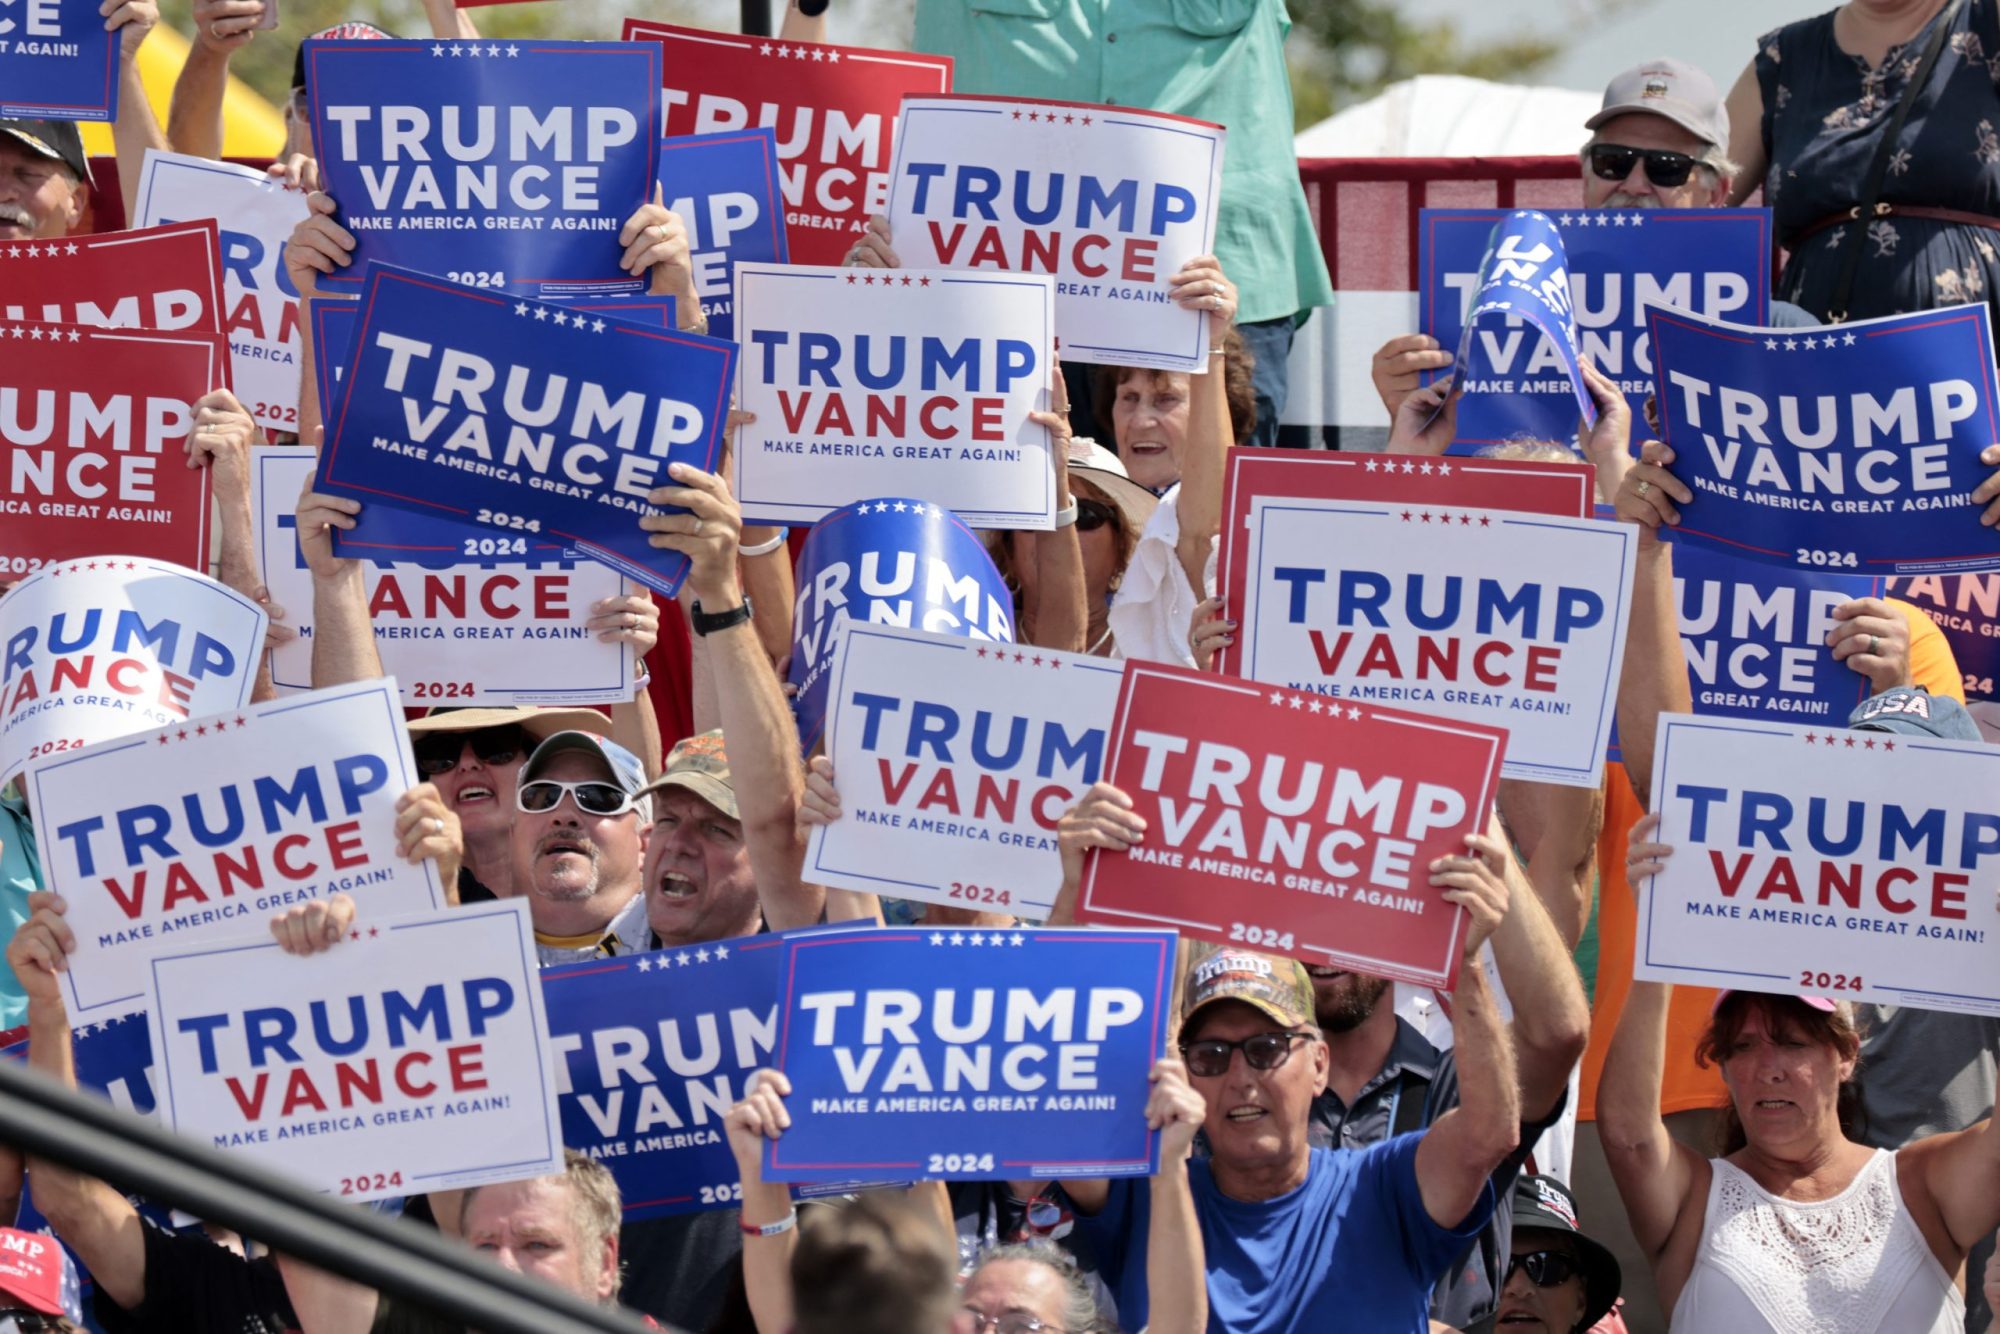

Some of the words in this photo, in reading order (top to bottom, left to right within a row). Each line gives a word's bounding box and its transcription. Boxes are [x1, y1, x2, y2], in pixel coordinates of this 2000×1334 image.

[15, 41, 78, 57] AGAIN!
[327, 106, 638, 162] TRUMP
[660, 87, 898, 168] TRUM
[359, 165, 600, 211] VANCE
[781, 164, 890, 216] NCE
[906, 163, 1197, 236] TRUMP
[349, 216, 393, 230] MAKE
[398, 216, 477, 230] AMERICA
[483, 217, 544, 230] GREAT
[551, 218, 617, 231] AGAIN!
[786, 212, 844, 231] GREAT
[928, 221, 1159, 283] VANCE
[447, 271, 505, 288] 2024
[1057, 283, 1100, 297] REAT
[1108, 288, 1171, 304] AGAIN!
[1443, 272, 1750, 327] TUMP
[700, 301, 731, 316] GAI
[229, 342, 293, 364] MERICA
[752, 329, 1036, 393] TRUMP
[375, 332, 703, 458] TRUMP
[1462, 380, 1514, 393] MAKE
[1520, 380, 1577, 393] AMER
[1610, 381, 1655, 394] REA
[1669, 369, 1978, 449] TRUMP
[0, 387, 192, 453] UMP
[256, 402, 296, 423] 202
[777, 390, 1005, 442] VANCE
[372, 437, 428, 462] MAKE
[433, 451, 521, 485] AMERICA
[529, 476, 592, 500] GREAT
[402, 397, 660, 500] VANCE
[764, 440, 803, 454] MAKE
[810, 443, 885, 458] AMERICA
[893, 446, 952, 460] GREAT
[960, 448, 1021, 462] AGAIN!
[1703, 434, 1951, 495] VANCE
[11, 449, 156, 502] NCE
[1694, 475, 1738, 499] MAKE
[1743, 489, 1825, 513] AMERICA
[1831, 499, 1894, 513] GREAT
[1902, 492, 1971, 511] AGAIN!
[39, 501, 101, 518] GREAT
[107, 509, 172, 523] AGAIN!
[476, 509, 540, 533] 2024
[464, 538, 527, 556] 2024
[1796, 548, 1859, 568] 2024
[369, 575, 570, 618] ANCE
[1273, 566, 1605, 644] TRUMP
[1673, 578, 1854, 645] UMP
[374, 626, 445, 639] MERICA
[454, 626, 514, 639] GREAT
[522, 626, 589, 639] AGAIN!
[1923, 609, 1973, 633] RICA
[3, 608, 235, 684] RUMP
[1308, 630, 1562, 694] VANCE
[1683, 639, 1817, 694] NCE
[414, 682, 475, 698] 2024
[1349, 685, 1435, 701] AMERICA
[1443, 690, 1504, 708] GREAT
[1509, 698, 1571, 715] AGAIN!
[1700, 691, 1760, 709] GREAT
[1766, 698, 1829, 714] AGAIN!
[1862, 694, 1930, 720] USA
[1964, 674, 1994, 694] 24
[4, 697, 65, 735] AMERICA
[73, 695, 136, 712] GREAT
[143, 709, 178, 727] AGA
[28, 738, 84, 760] 2024
[852, 692, 1106, 786] TRUM
[878, 758, 1074, 831] VANC
[1133, 730, 1467, 841] TRUMP
[57, 753, 389, 878] TRUMP
[856, 809, 901, 827] MAKE
[908, 817, 990, 842] AMERICA
[998, 832, 1060, 851] GREAT
[1676, 784, 2000, 870] TRUMP
[1158, 797, 1417, 890] VANCE
[102, 821, 370, 920] VANCE
[1129, 847, 1183, 868] MAKE
[1188, 857, 1277, 886] AMERICA
[1284, 876, 1349, 899] GREAT
[1353, 888, 1424, 914] AGAIN!
[1708, 850, 1969, 920] VANCE
[98, 925, 154, 949] MAKE
[161, 904, 249, 934] AMERICA
[256, 886, 319, 911] GREAT
[327, 868, 394, 895] AGAIN!
[949, 882, 1011, 907] 2024
[1229, 923, 1295, 951] 2024
[1686, 902, 1740, 919] MAKE
[1749, 908, 1837, 928] AMERICA
[1846, 918, 1909, 935] GREAT
[1916, 924, 1984, 943] AGAIN!
[1195, 957, 1273, 986] Trump
[1800, 971, 1863, 992] 2024
[178, 976, 515, 1075] TRUMP
[800, 988, 1144, 1046] TRUMP
[549, 1003, 778, 1094] TRUM
[832, 1044, 1099, 1093] VANCE
[224, 1043, 490, 1122] VANCE
[577, 1070, 760, 1137] VAN
[812, 1099, 869, 1114] MAKE
[875, 1098, 966, 1113] AMERICA
[973, 1097, 1039, 1112] GREAT
[1045, 1096, 1115, 1111] AGAIN!
[214, 1127, 269, 1149] MAKE
[277, 1116, 364, 1140] AMERICA
[373, 1105, 435, 1126] GREAT
[443, 1095, 511, 1116] AGAIN!
[634, 1130, 720, 1153] AMERICA
[340, 1171, 404, 1196] 2024
[928, 1155, 994, 1172] 2024
[699, 1182, 743, 1204] 202
